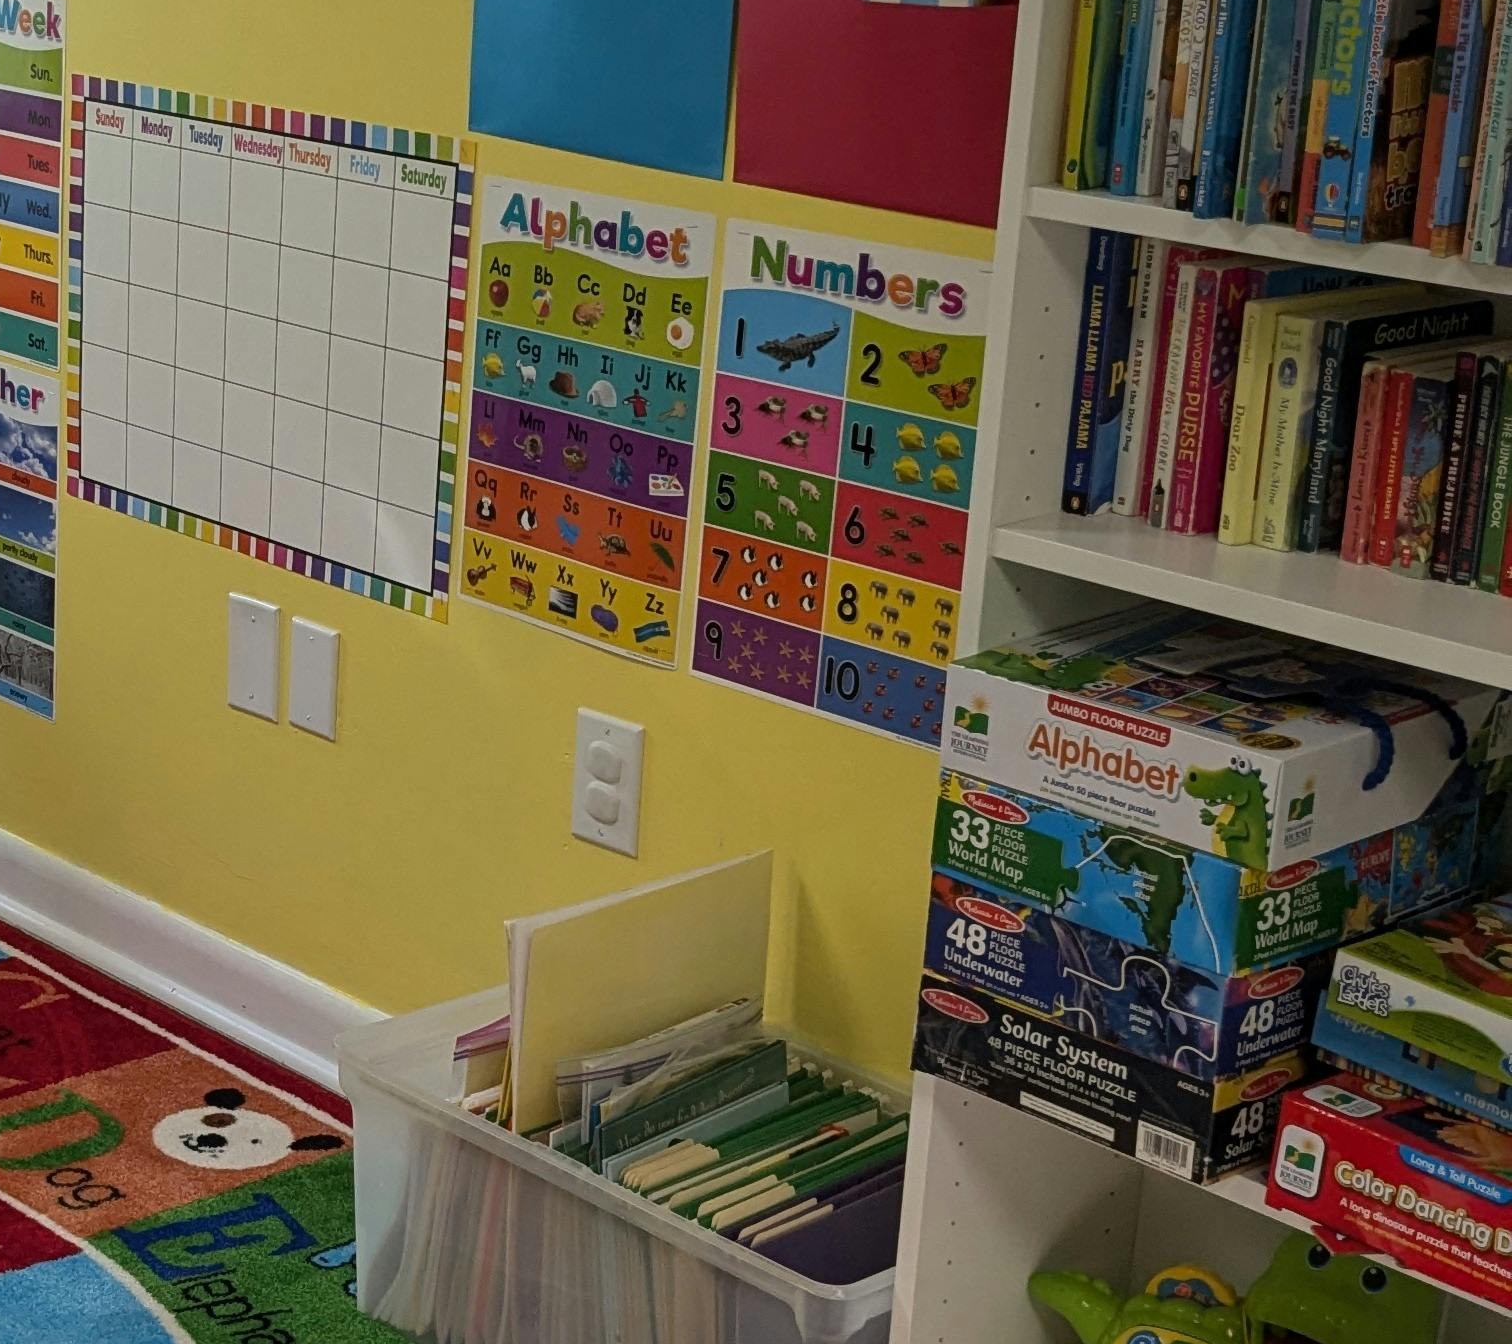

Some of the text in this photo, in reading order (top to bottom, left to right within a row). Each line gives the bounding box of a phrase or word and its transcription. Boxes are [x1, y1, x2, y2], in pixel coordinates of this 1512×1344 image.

[29, 63, 54, 83] Sun.
[94, 107, 448, 195] Sunday Monday Tuesday Wednesday Thursday Friday Saturday
[499, 192, 689, 265] Alphabet
[23, 243, 54, 266] Thurs.
[750, 234, 967, 317] Numbers
[489, 256, 693, 316] Aa Bb Cc Dd Ee
[27, 333, 48, 352] Sat.
[1374, 310, 1470, 345] Good Night
[517, 336, 688, 394] Gg Kk
[859, 342, 881, 387] 2
[721, 395, 742, 436] 3
[1176, 391, 1206, 463] PURSE
[1228, 402, 1246, 472] Dear Zoo
[1307, 356, 1337, 505] Good Night Maryland
[850, 421, 876, 467] 4
[715, 473, 736, 513] 5
[1490, 440, 1512, 529] JUNGLE BOOK
[650, 520, 673, 542] Uu
[644, 592, 665, 615] Zz
[836, 582, 858, 625] 8
[824, 655, 862, 703] 10
[1051, 699, 1168, 744] JUMBO FLOOR PUZZLE
[1027, 722, 1179, 795] Alphabet
[950, 809, 1025, 849] 33 PIECE
[991, 833, 1026, 854] FLOOR
[948, 839, 1024, 882] World Map
[991, 844, 1029, 866] PUZZLE
[946, 917, 987, 956] 48
[943, 944, 1024, 988] Underwater
[1339, 965, 1390, 999] Chutes
[1336, 981, 1390, 1018] Ladders
[999, 1013, 1128, 1080] Solar System
[987, 1035, 1137, 1104] 48 PIECE FLOOR PUZZLE
[1409, 1152, 1503, 1201] Long Tall Puzzle
[1336, 1161, 1493, 1251] Color Dancing
